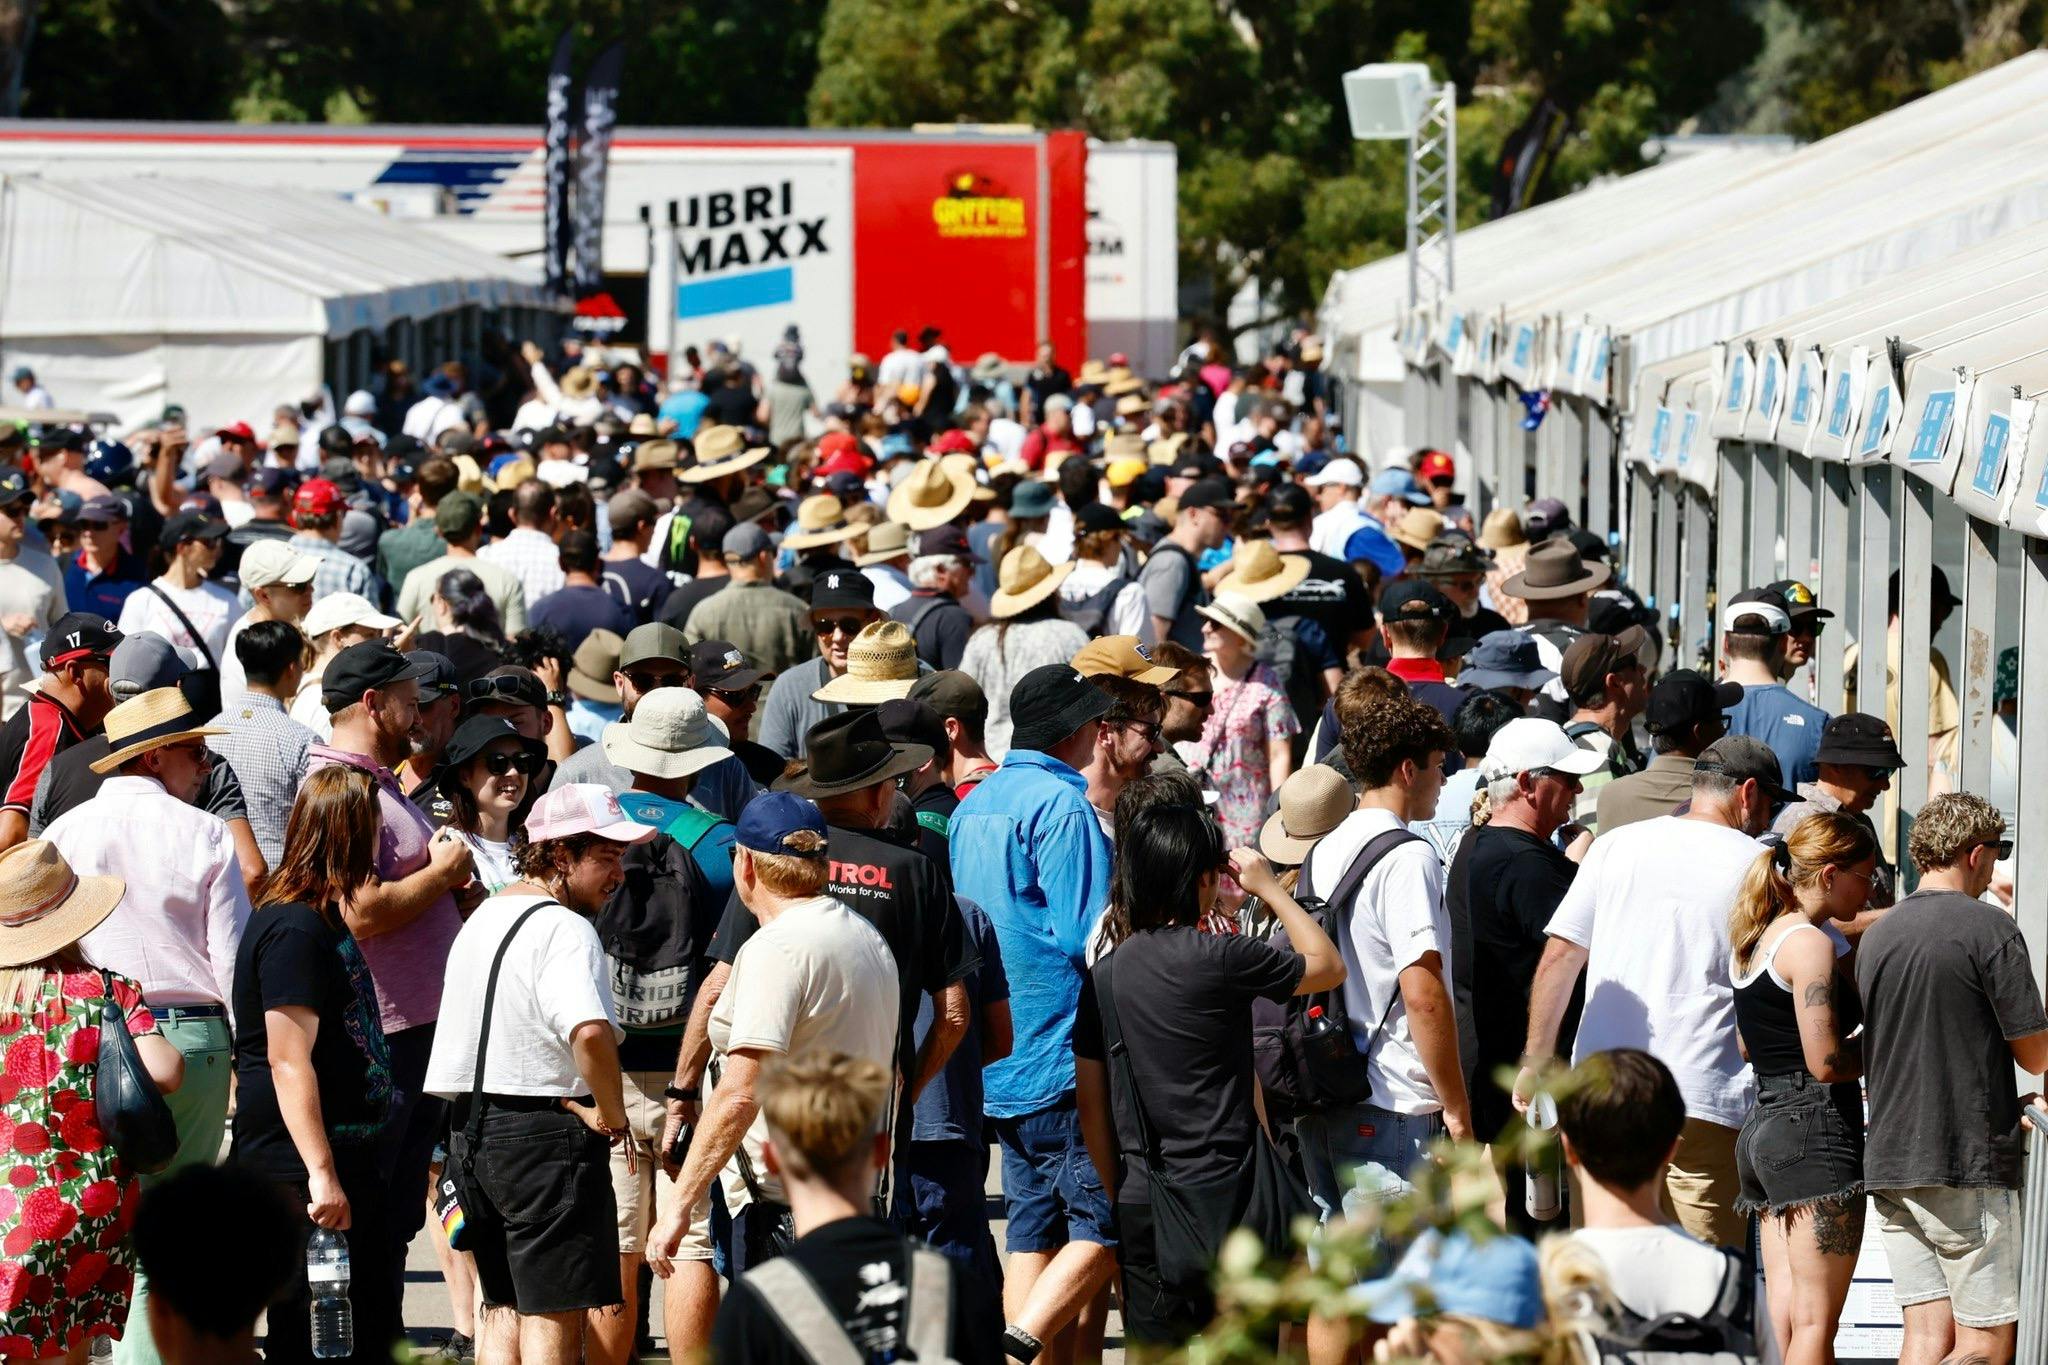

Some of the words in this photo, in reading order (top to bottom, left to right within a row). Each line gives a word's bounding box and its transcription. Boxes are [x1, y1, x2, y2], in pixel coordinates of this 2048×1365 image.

[66, 631, 80, 648] 17
[828, 883, 857, 895] Works
[859, 886, 873, 897] for
